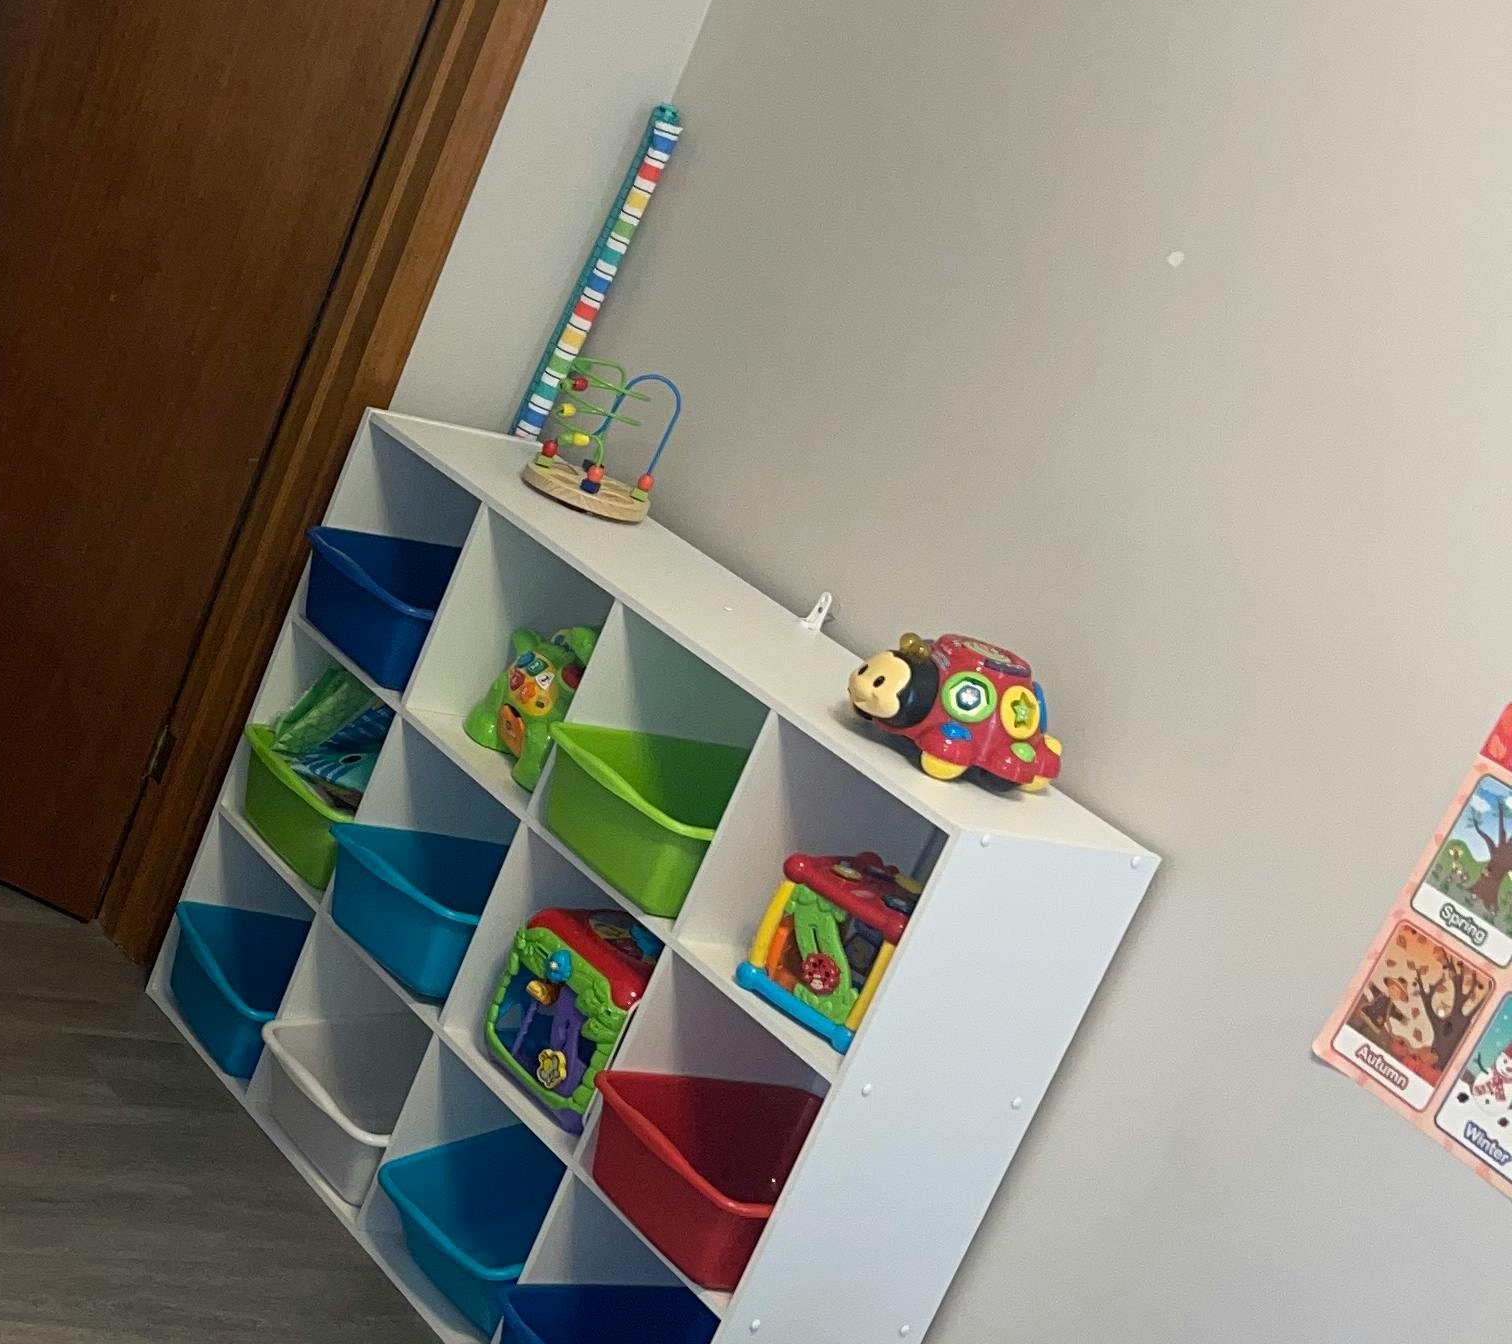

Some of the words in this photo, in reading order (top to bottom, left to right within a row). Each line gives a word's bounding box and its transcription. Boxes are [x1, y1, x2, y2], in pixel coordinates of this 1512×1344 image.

[1440, 903, 1487, 945] Spring
[1355, 1043, 1408, 1090] Autumn
[1464, 1121, 1511, 1165] Winter
